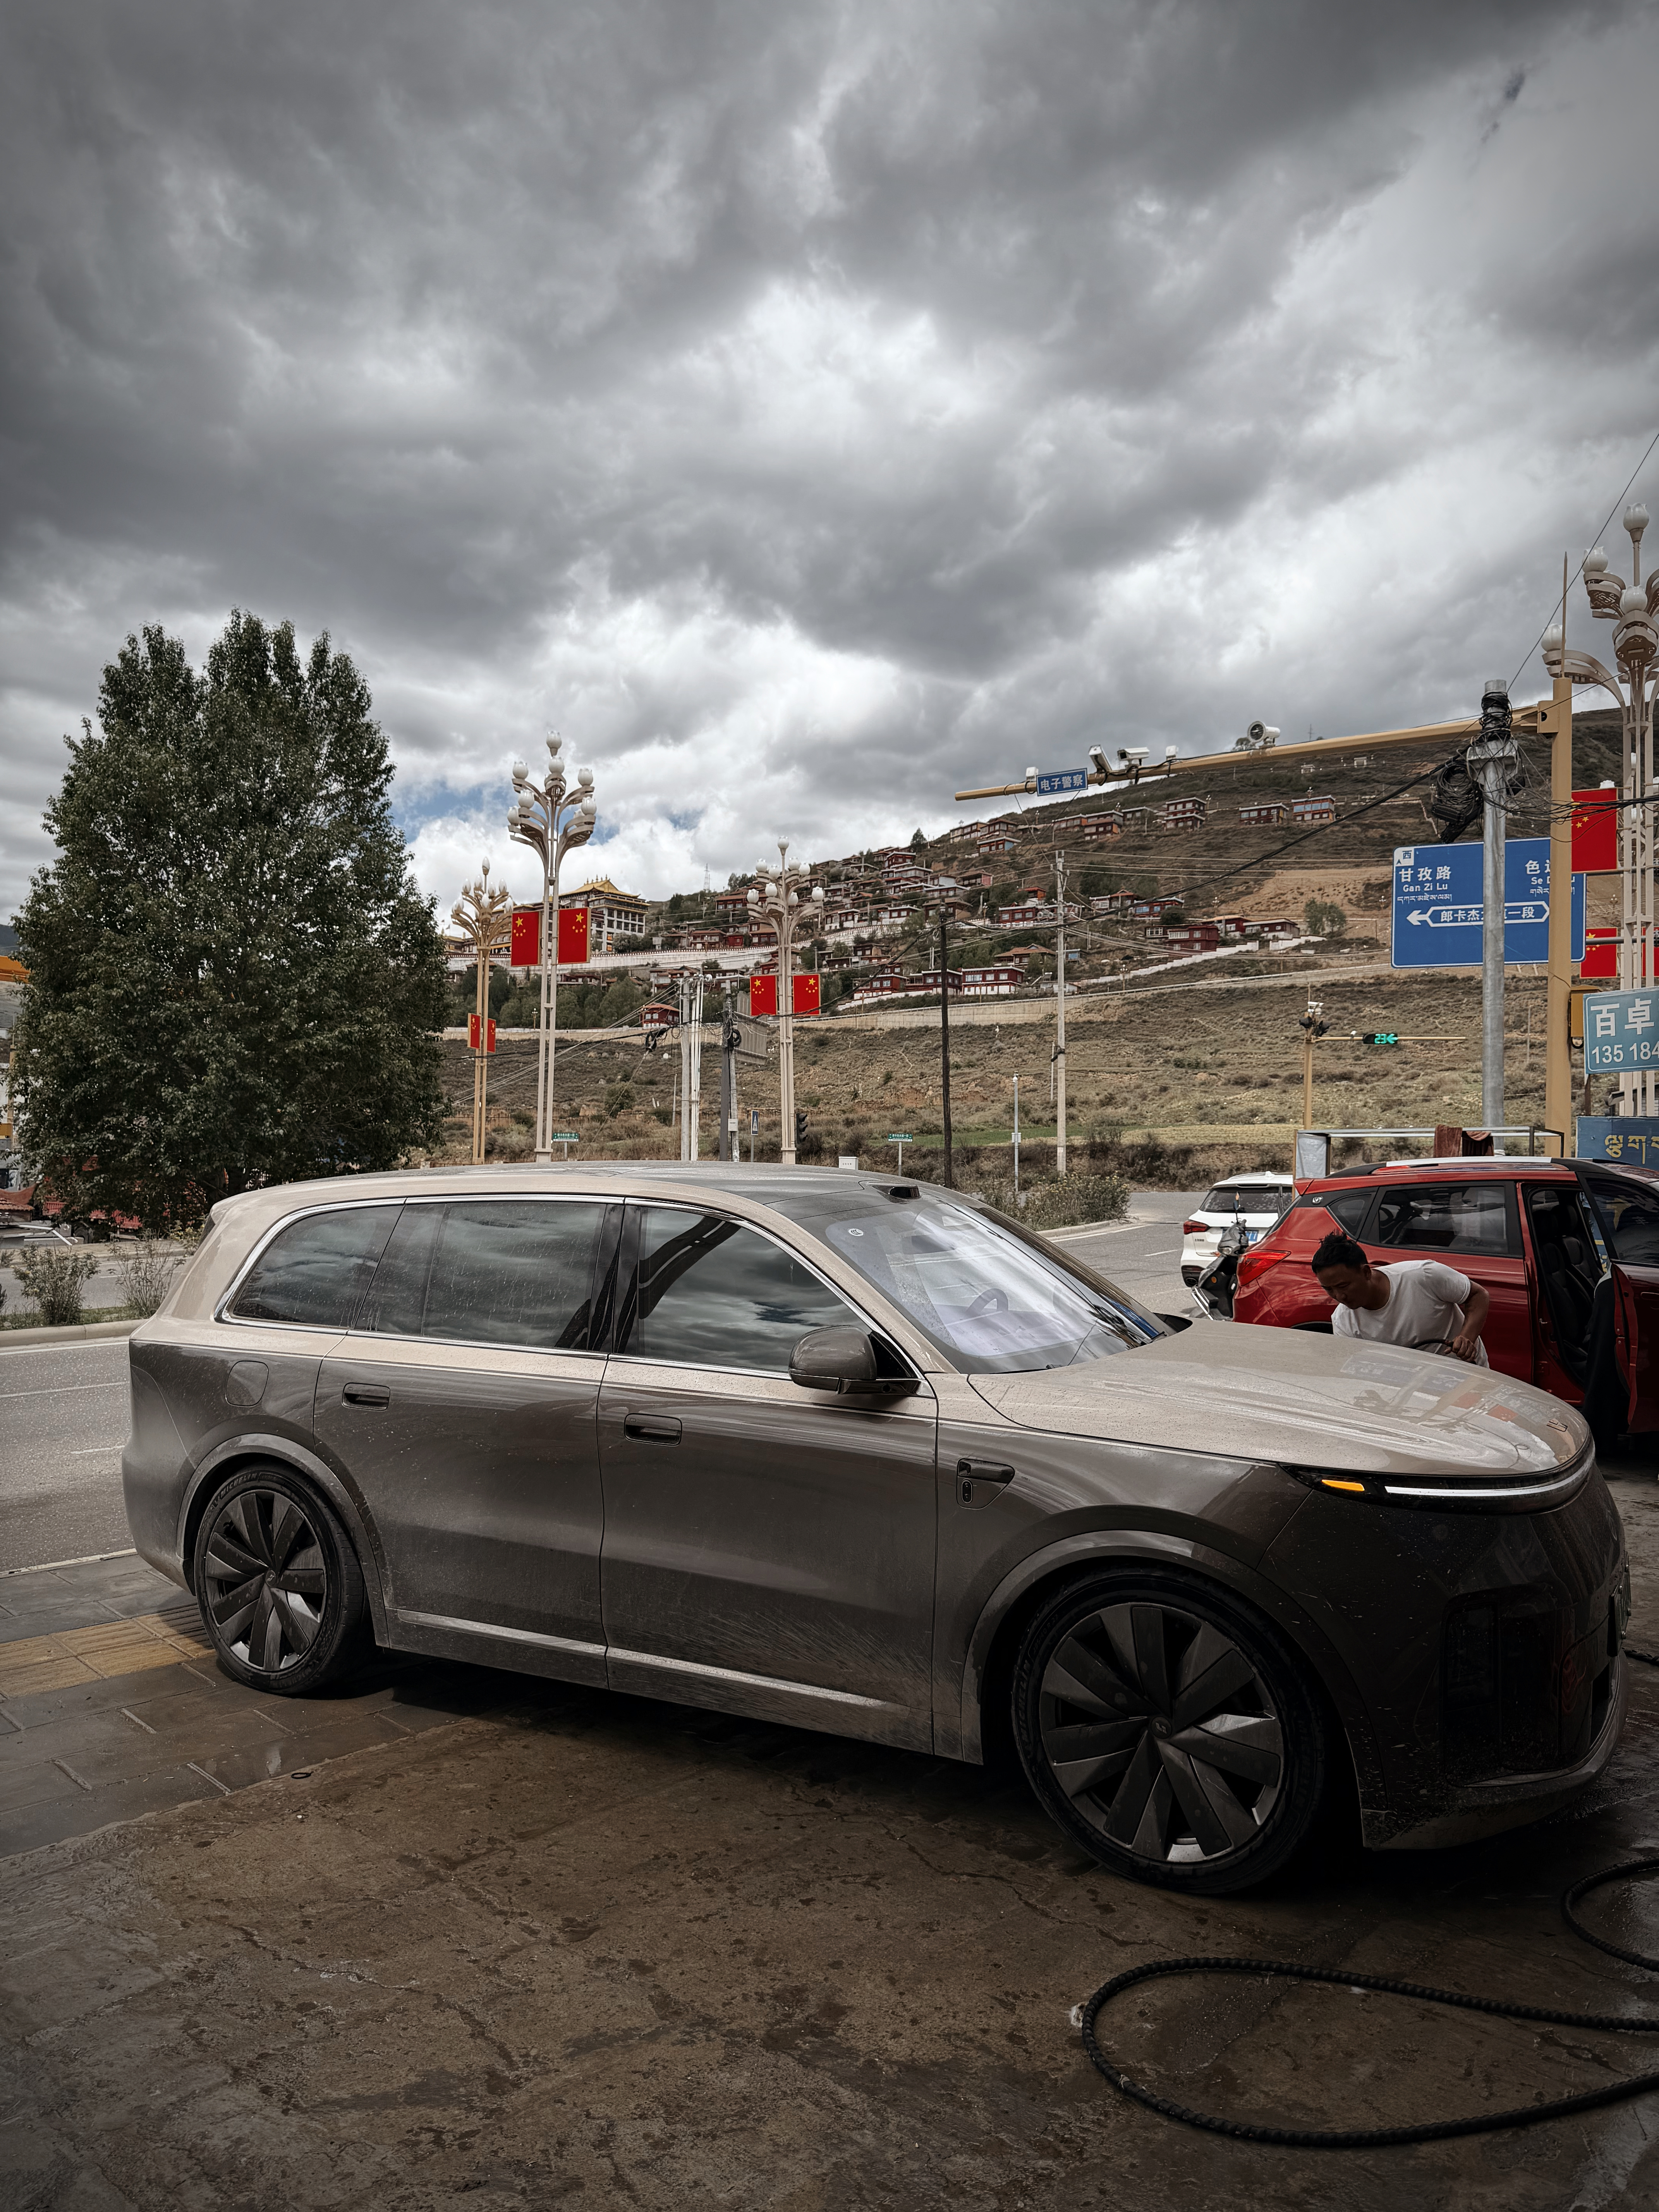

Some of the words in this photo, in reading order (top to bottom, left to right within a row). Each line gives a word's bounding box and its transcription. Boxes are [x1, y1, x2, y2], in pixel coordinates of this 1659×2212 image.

[1041, 774, 1083, 791] 电子警察
[1402, 850, 1412, 859] 西
[1399, 866, 1451, 883] 甘孜路
[1440, 906, 1535, 922] 郎卡杰一段
[1590, 998, 1659, 1038] 百卓
[1374, 1034, 1387, 1044] 23
[1592, 1044, 1623, 1064] 135
